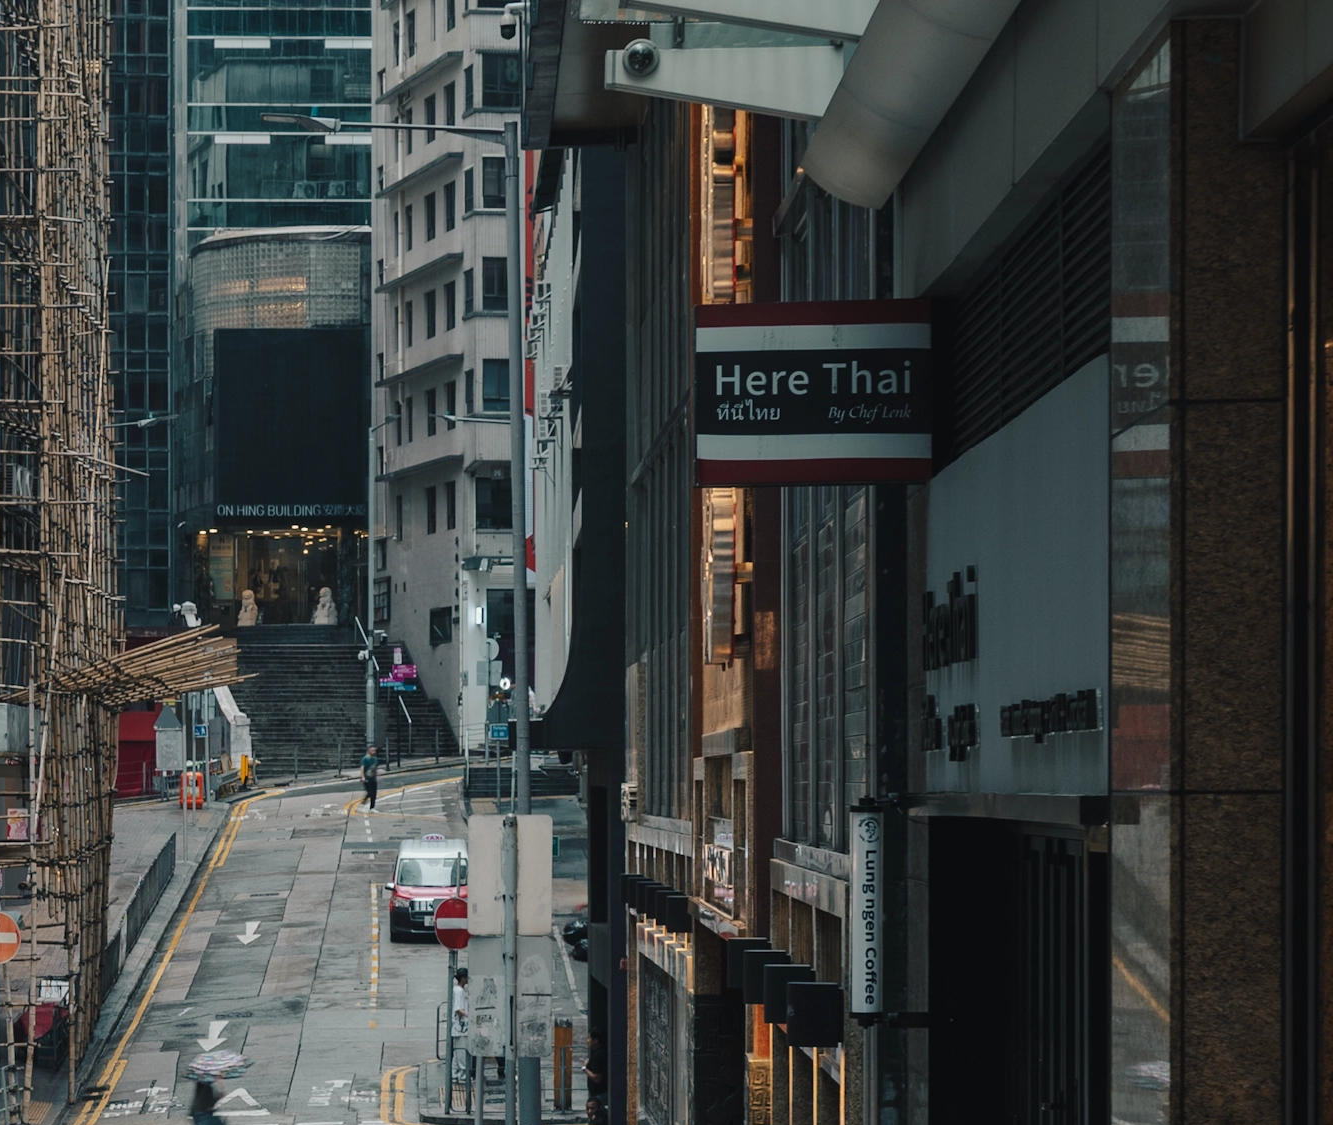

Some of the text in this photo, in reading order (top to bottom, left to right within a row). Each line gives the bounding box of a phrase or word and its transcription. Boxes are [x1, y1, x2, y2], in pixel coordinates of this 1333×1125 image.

[715, 359, 911, 396] Here Thai
[828, 406, 845, 424] By
[849, 404, 881, 424] Chef
[216, 504, 233, 517] ON
[236, 504, 265, 517] HING
[267, 504, 322, 517] BUILDING
[861, 849, 877, 1006] Lung ngen Coffee
